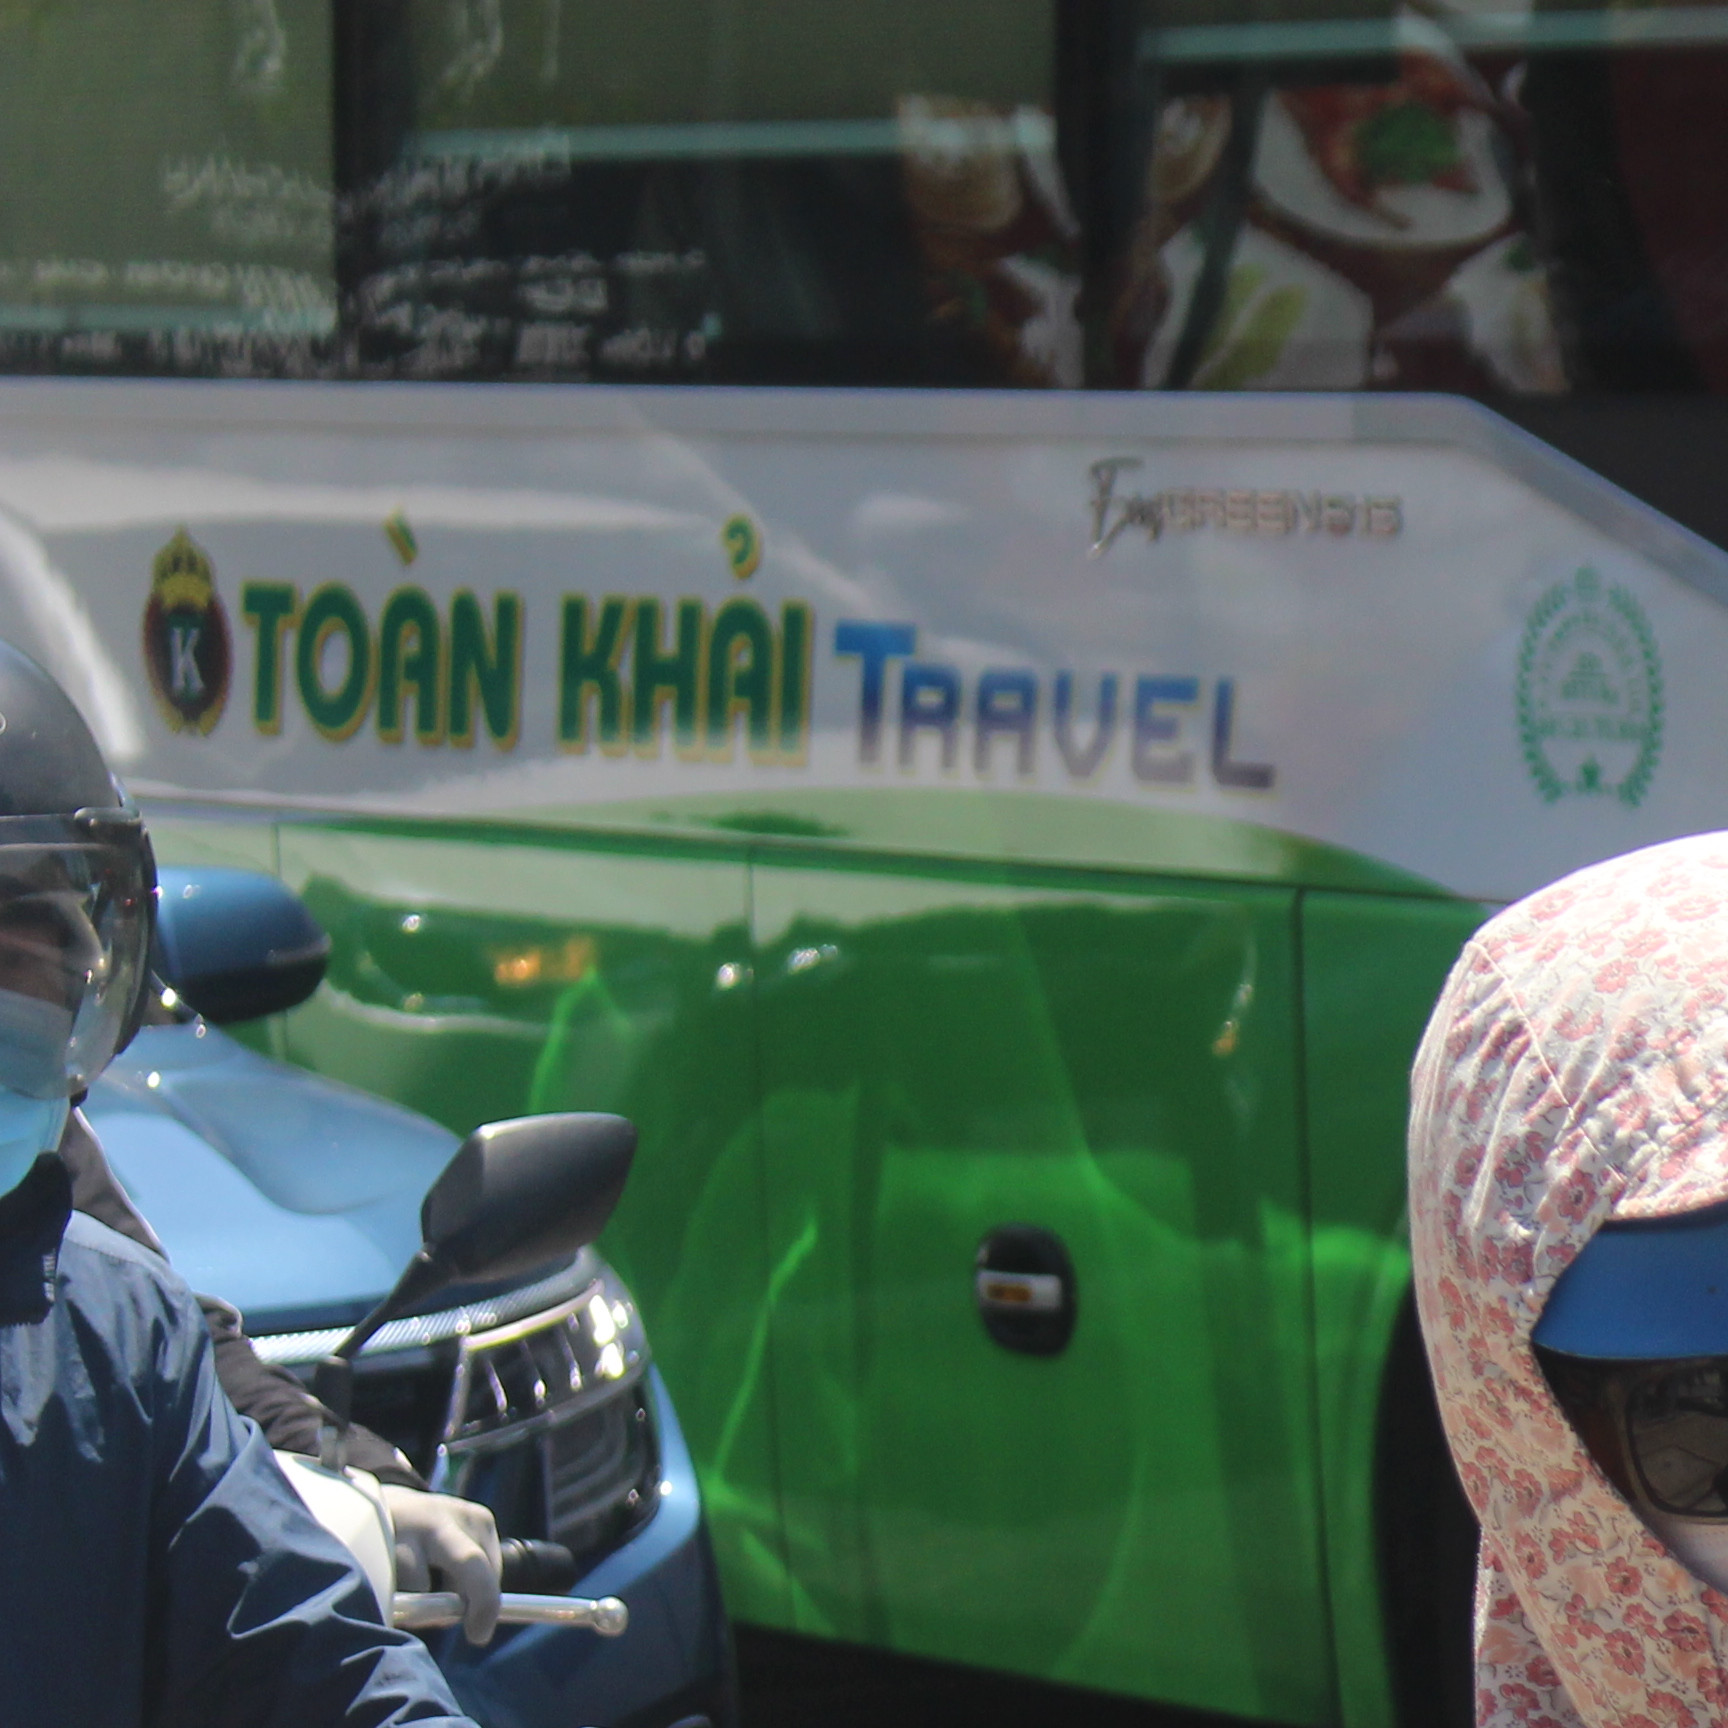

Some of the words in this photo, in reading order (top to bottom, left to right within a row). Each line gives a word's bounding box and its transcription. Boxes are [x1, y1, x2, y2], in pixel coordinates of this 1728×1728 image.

[171, 626, 205, 692] K
[241, 504, 524, 752] TOÀN
[557, 513, 814, 768] KHẢI
